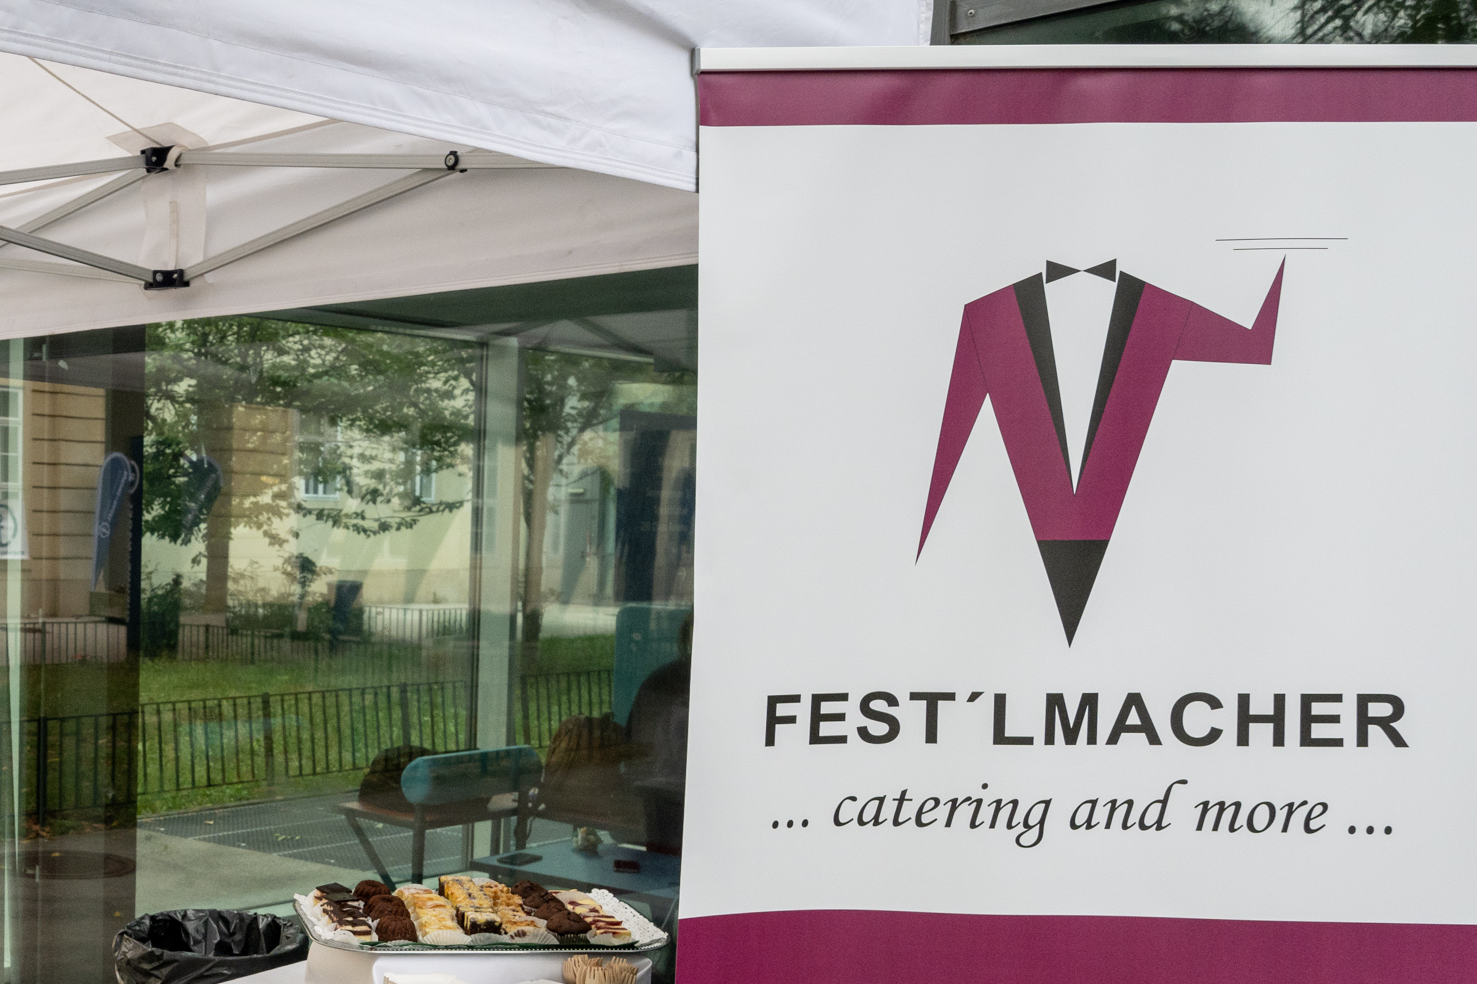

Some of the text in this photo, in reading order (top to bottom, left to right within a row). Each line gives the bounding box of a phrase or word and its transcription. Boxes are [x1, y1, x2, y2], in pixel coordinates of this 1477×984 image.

[771, 779, 1393, 849] ... catering and more ...
